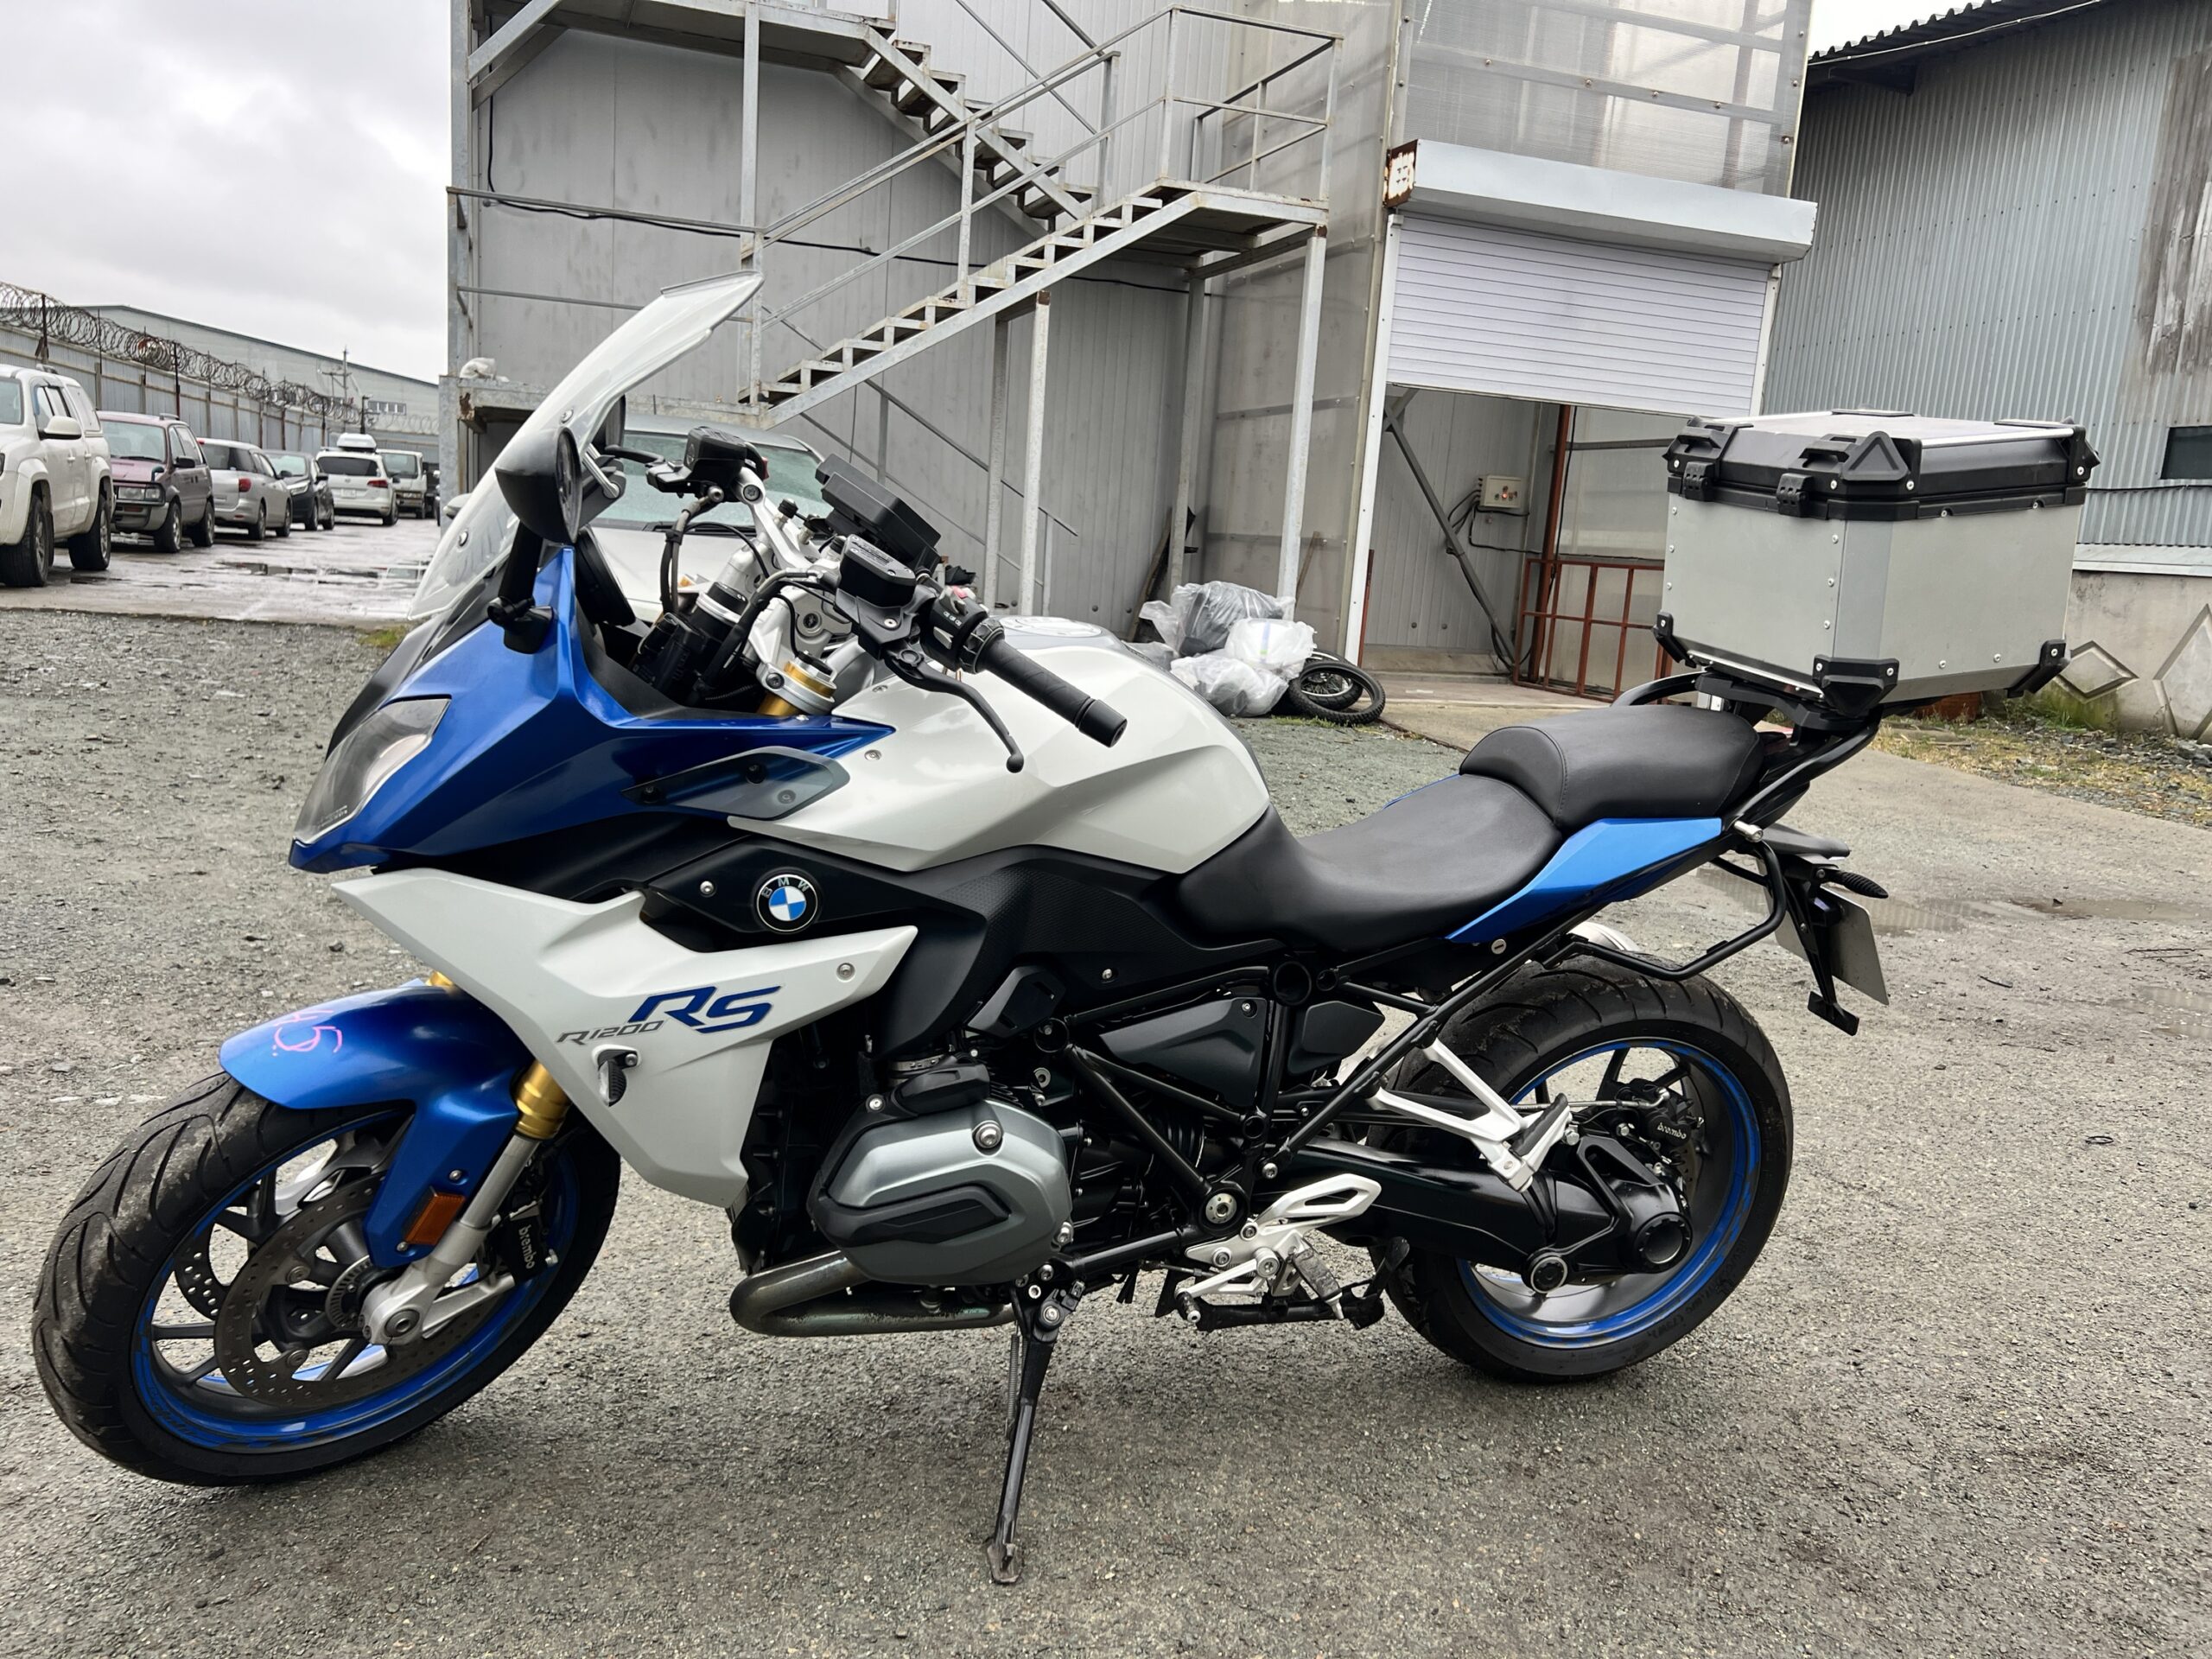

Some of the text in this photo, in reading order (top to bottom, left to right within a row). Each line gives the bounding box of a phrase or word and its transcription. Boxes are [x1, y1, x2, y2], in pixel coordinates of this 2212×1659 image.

[760, 876, 810, 899] BMW
[556, 985, 781, 1046] R1200 RS
[1656, 1122, 1687, 1140] brembo
[518, 1224, 537, 1269] brembo
